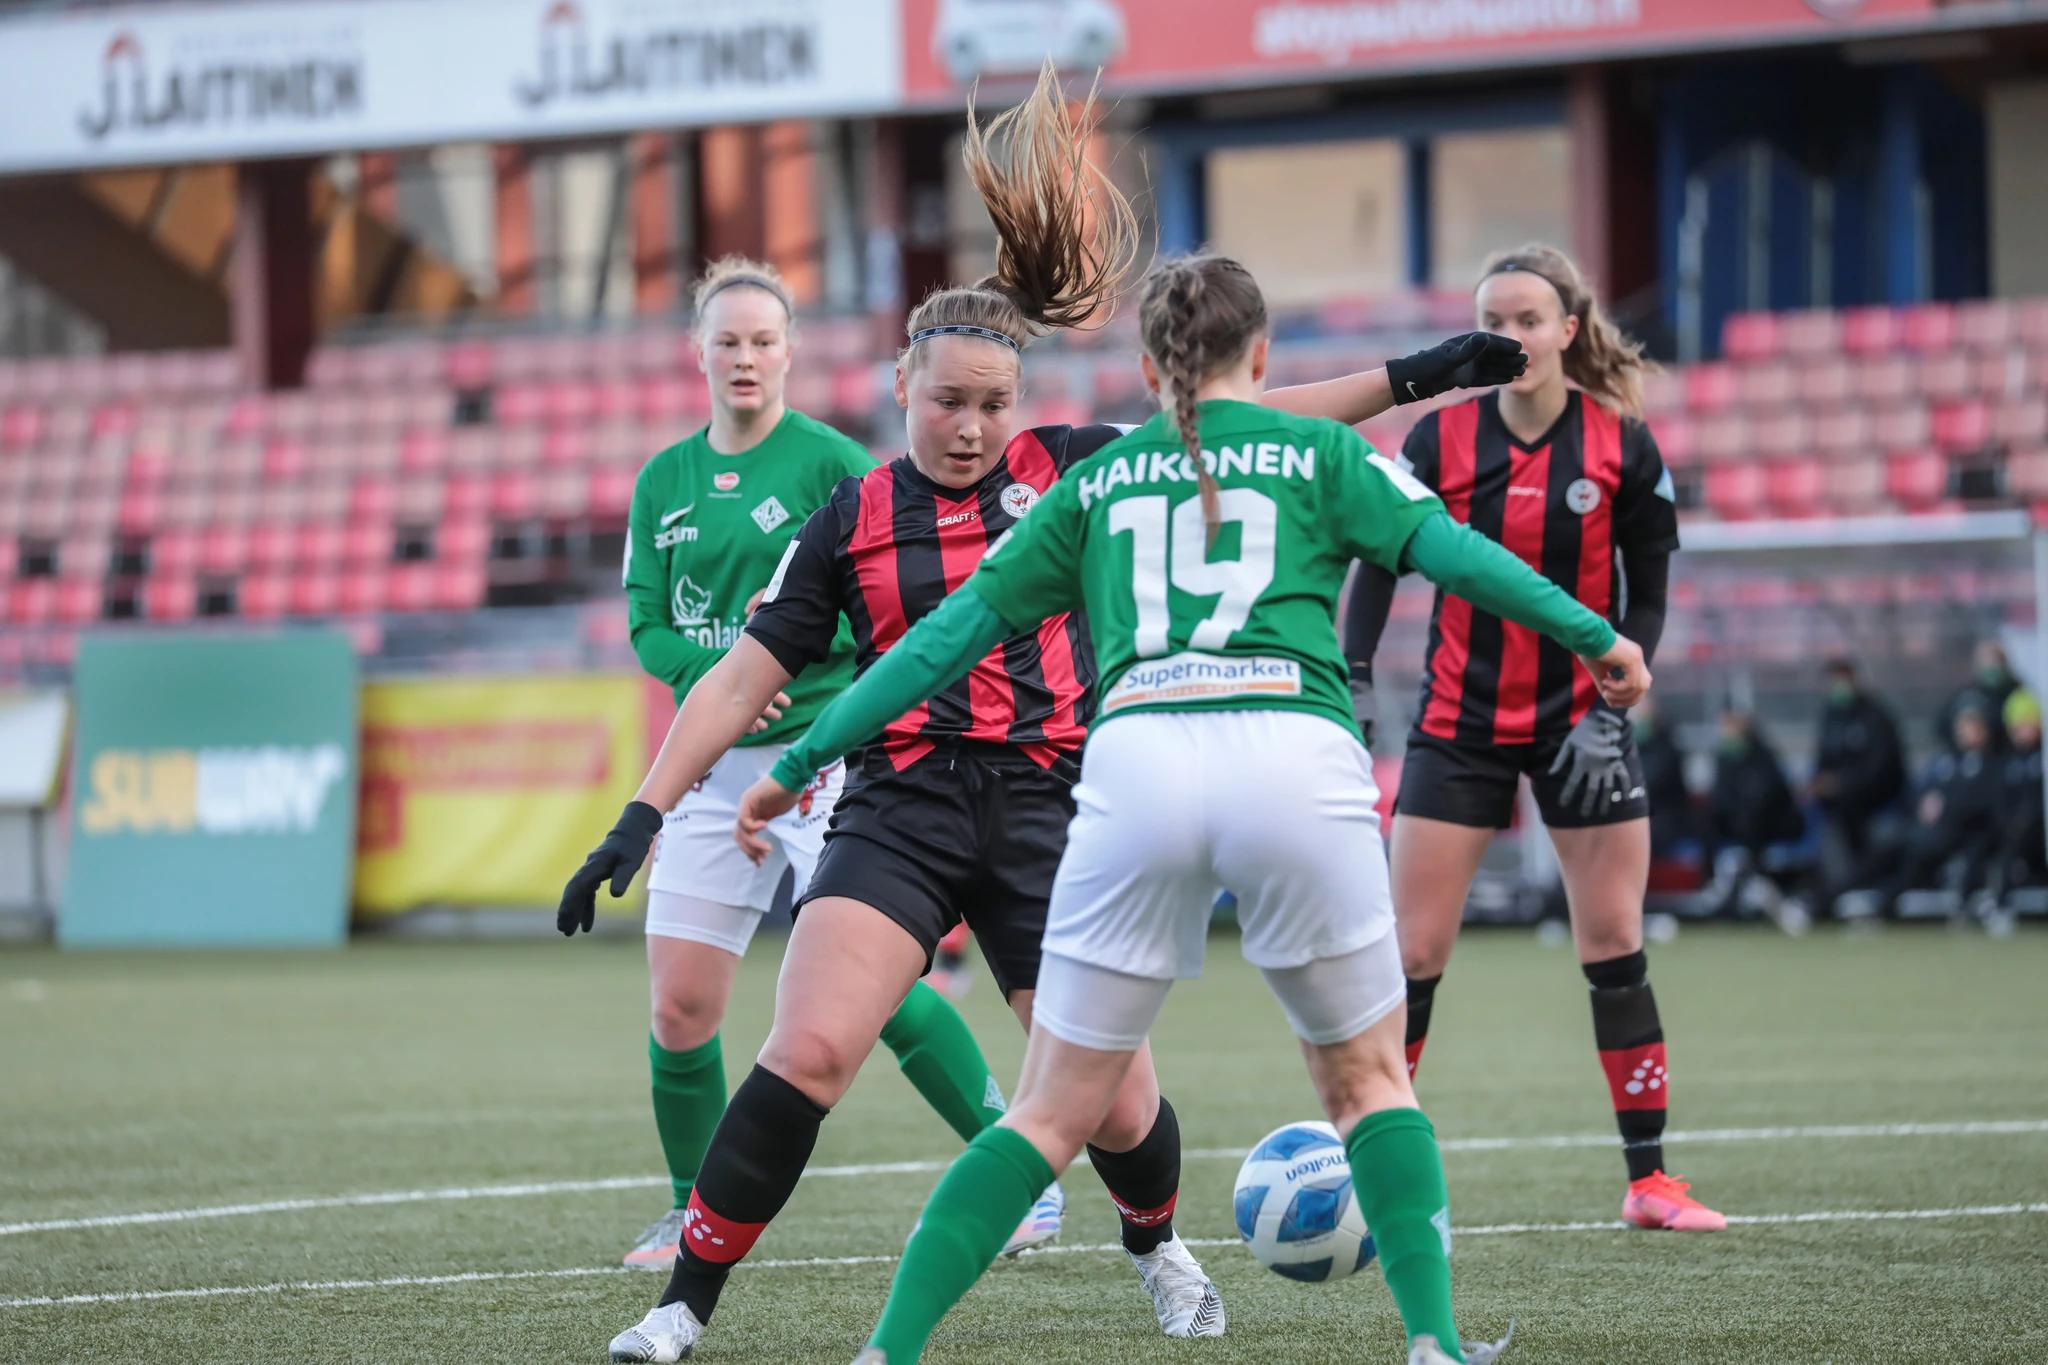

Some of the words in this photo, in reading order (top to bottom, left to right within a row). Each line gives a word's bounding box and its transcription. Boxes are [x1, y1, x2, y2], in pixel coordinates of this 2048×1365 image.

[1078, 442, 1316, 511] HAIKONEN
[937, 512, 970, 527] CRAFT
[1108, 487, 1277, 658] 19
[1126, 657, 1294, 689] Supermarket
